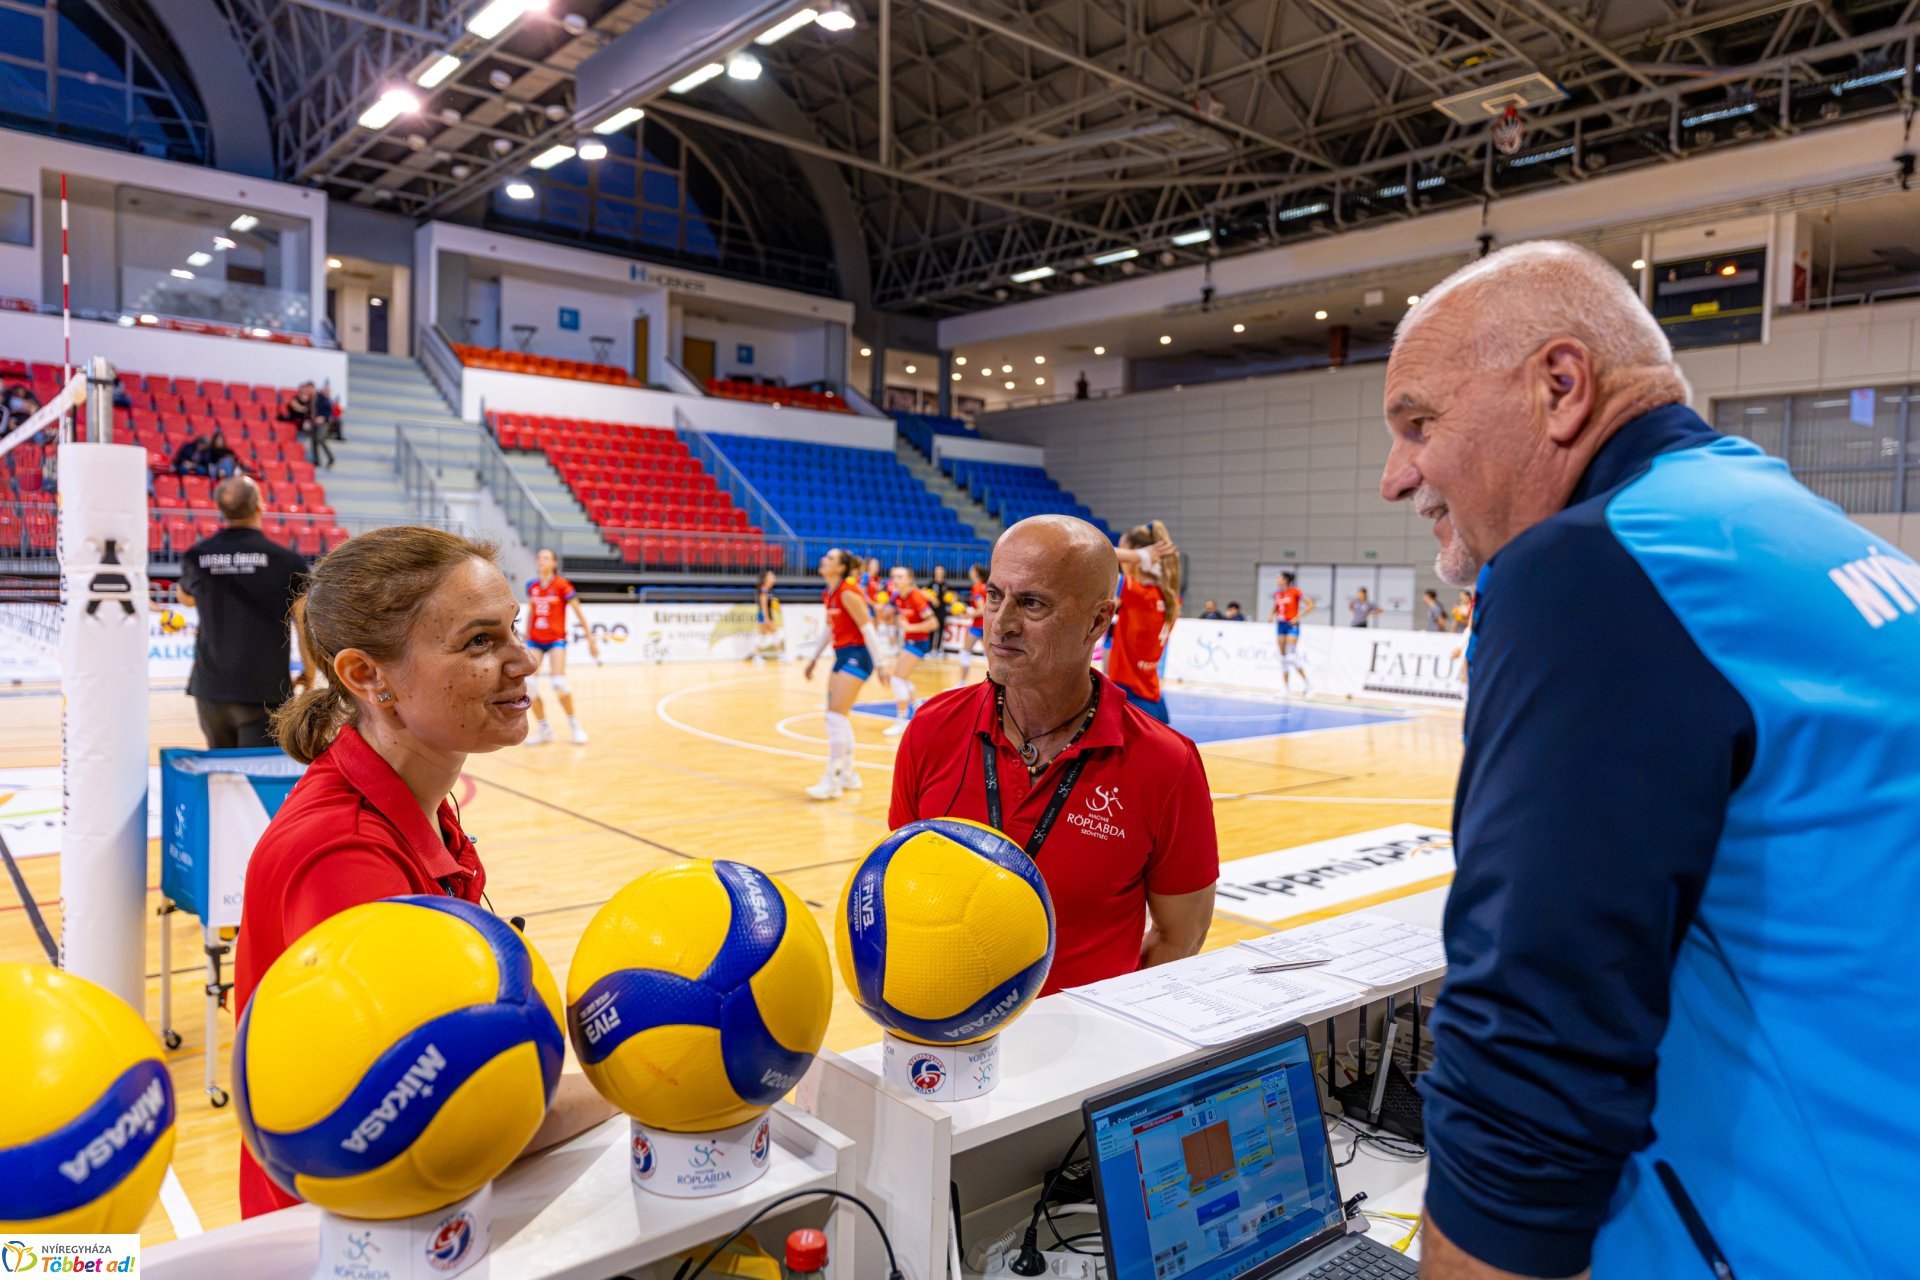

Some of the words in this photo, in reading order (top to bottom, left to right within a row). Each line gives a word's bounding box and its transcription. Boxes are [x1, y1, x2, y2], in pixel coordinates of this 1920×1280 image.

[1368, 640, 1460, 684] FATU
[1066, 812, 1125, 839] RÖPLABDA
[1088, 813, 1109, 823] MAGYAR
[944, 988, 1020, 1038] MIKASA
[341, 1043, 447, 1154] MIKASA
[58, 1077, 165, 1184] MIKASA
[677, 1170, 732, 1185] RÖPLABDA
